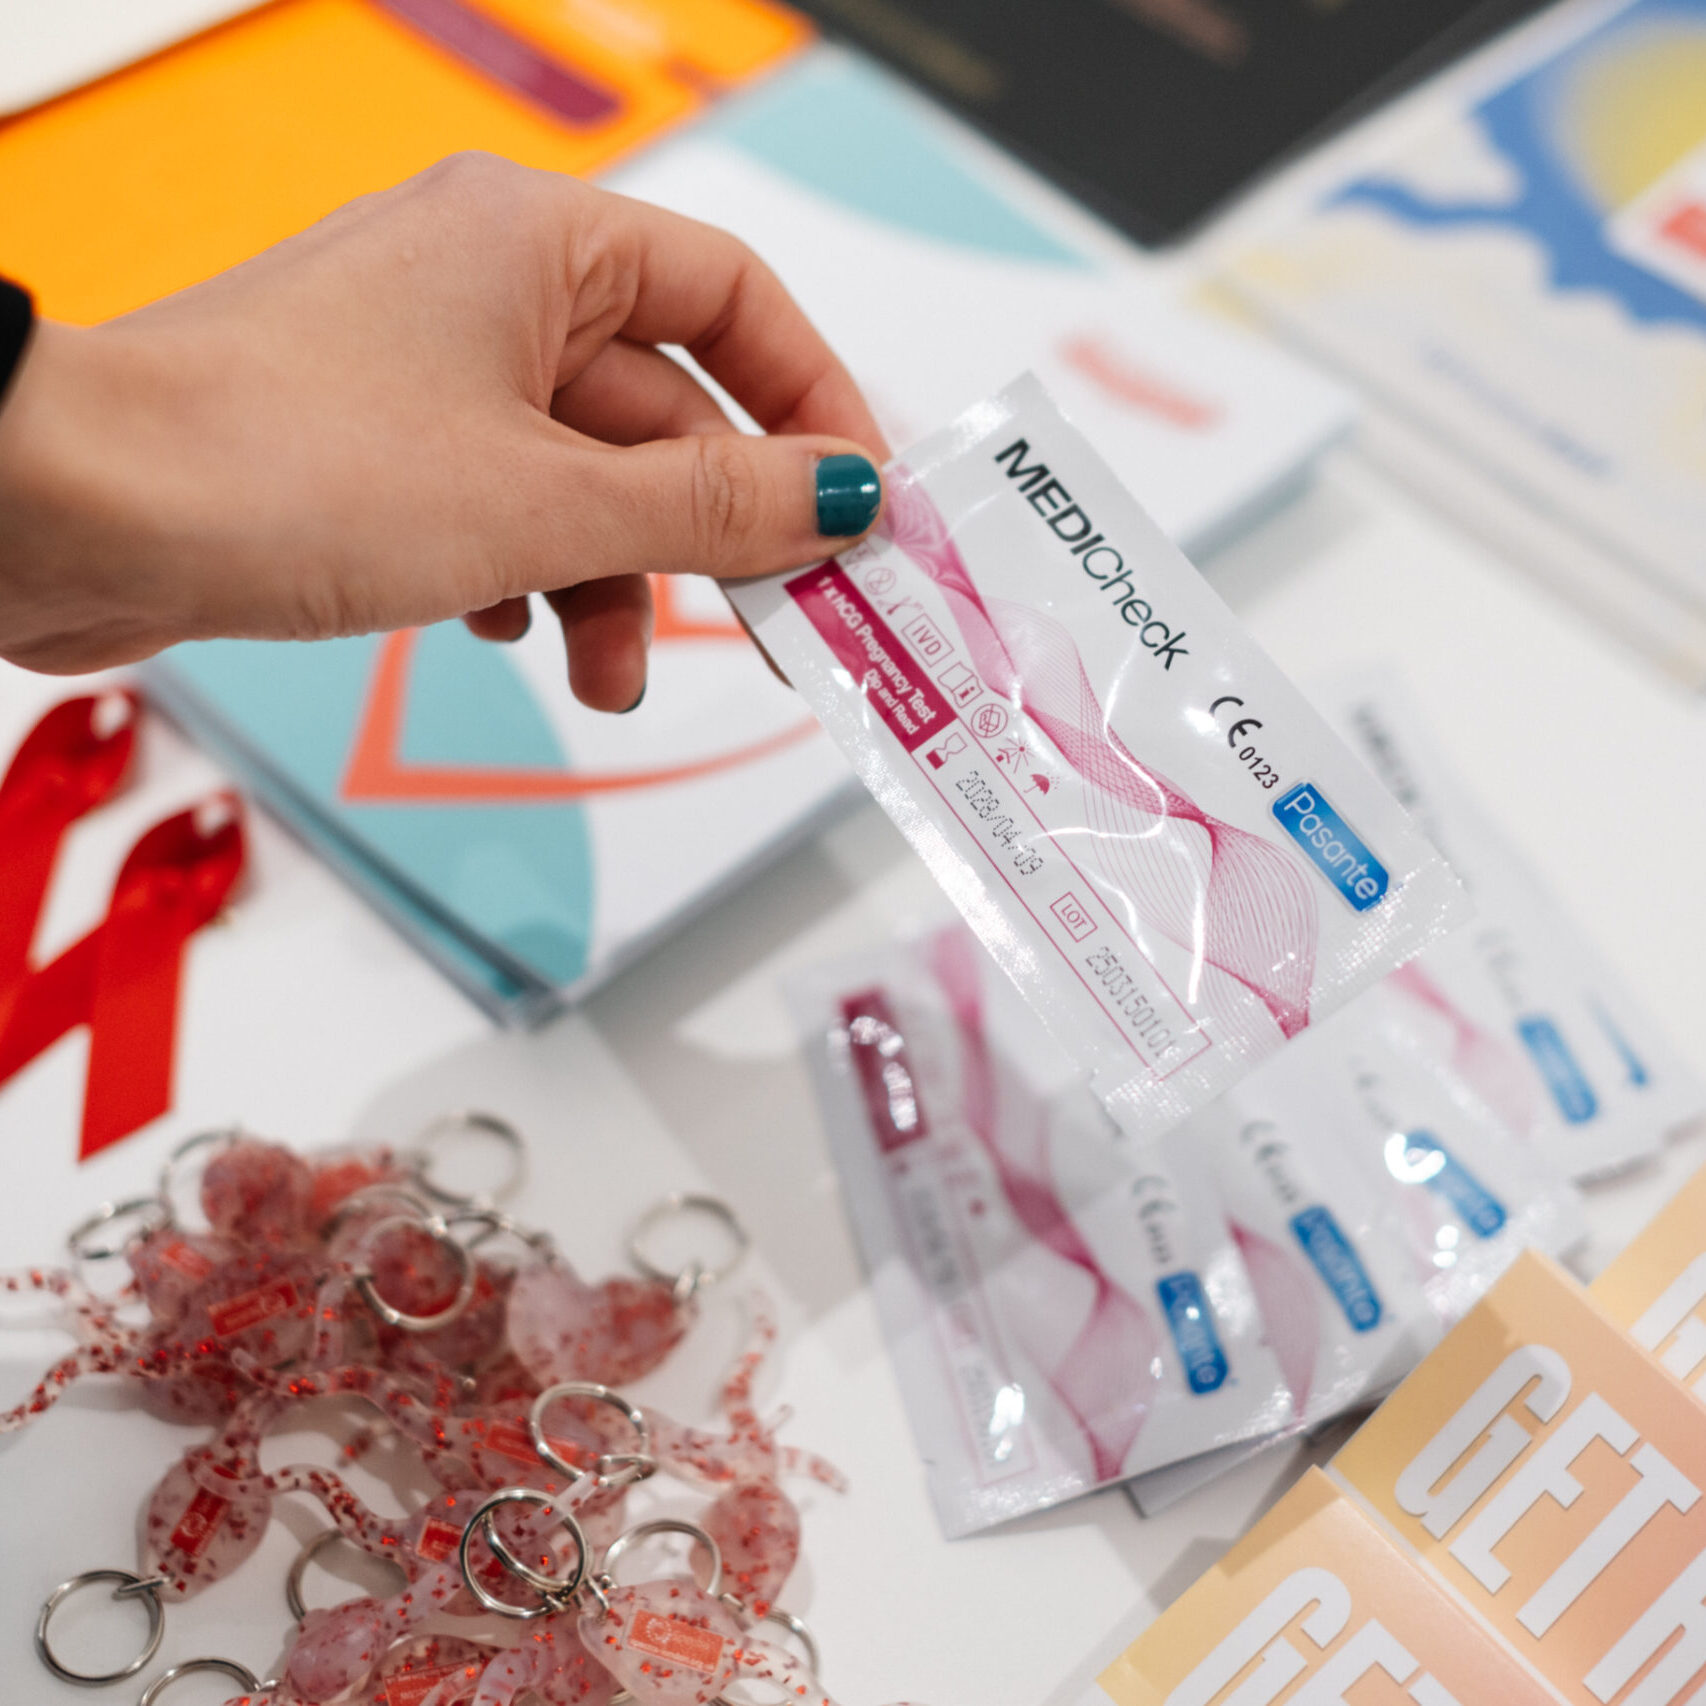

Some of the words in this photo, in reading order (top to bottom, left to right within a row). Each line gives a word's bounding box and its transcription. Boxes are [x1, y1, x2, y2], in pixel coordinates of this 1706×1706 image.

[994, 438, 1189, 671] MEDICheck
[832, 593, 864, 630] hCG
[855, 623, 913, 695] Pregnancy
[908, 688, 937, 724] Test
[912, 624, 941, 655] IVD
[864, 668, 883, 690] Dip
[878, 687, 899, 708] and
[892, 702, 921, 735] Read
[1239, 746, 1279, 789] 0123
[955, 769, 1044, 876] 2028/04/09
[1283, 790, 1379, 899] Pasante
[1060, 903, 1088, 930] LOT
[1394, 1343, 1704, 1642] GET
